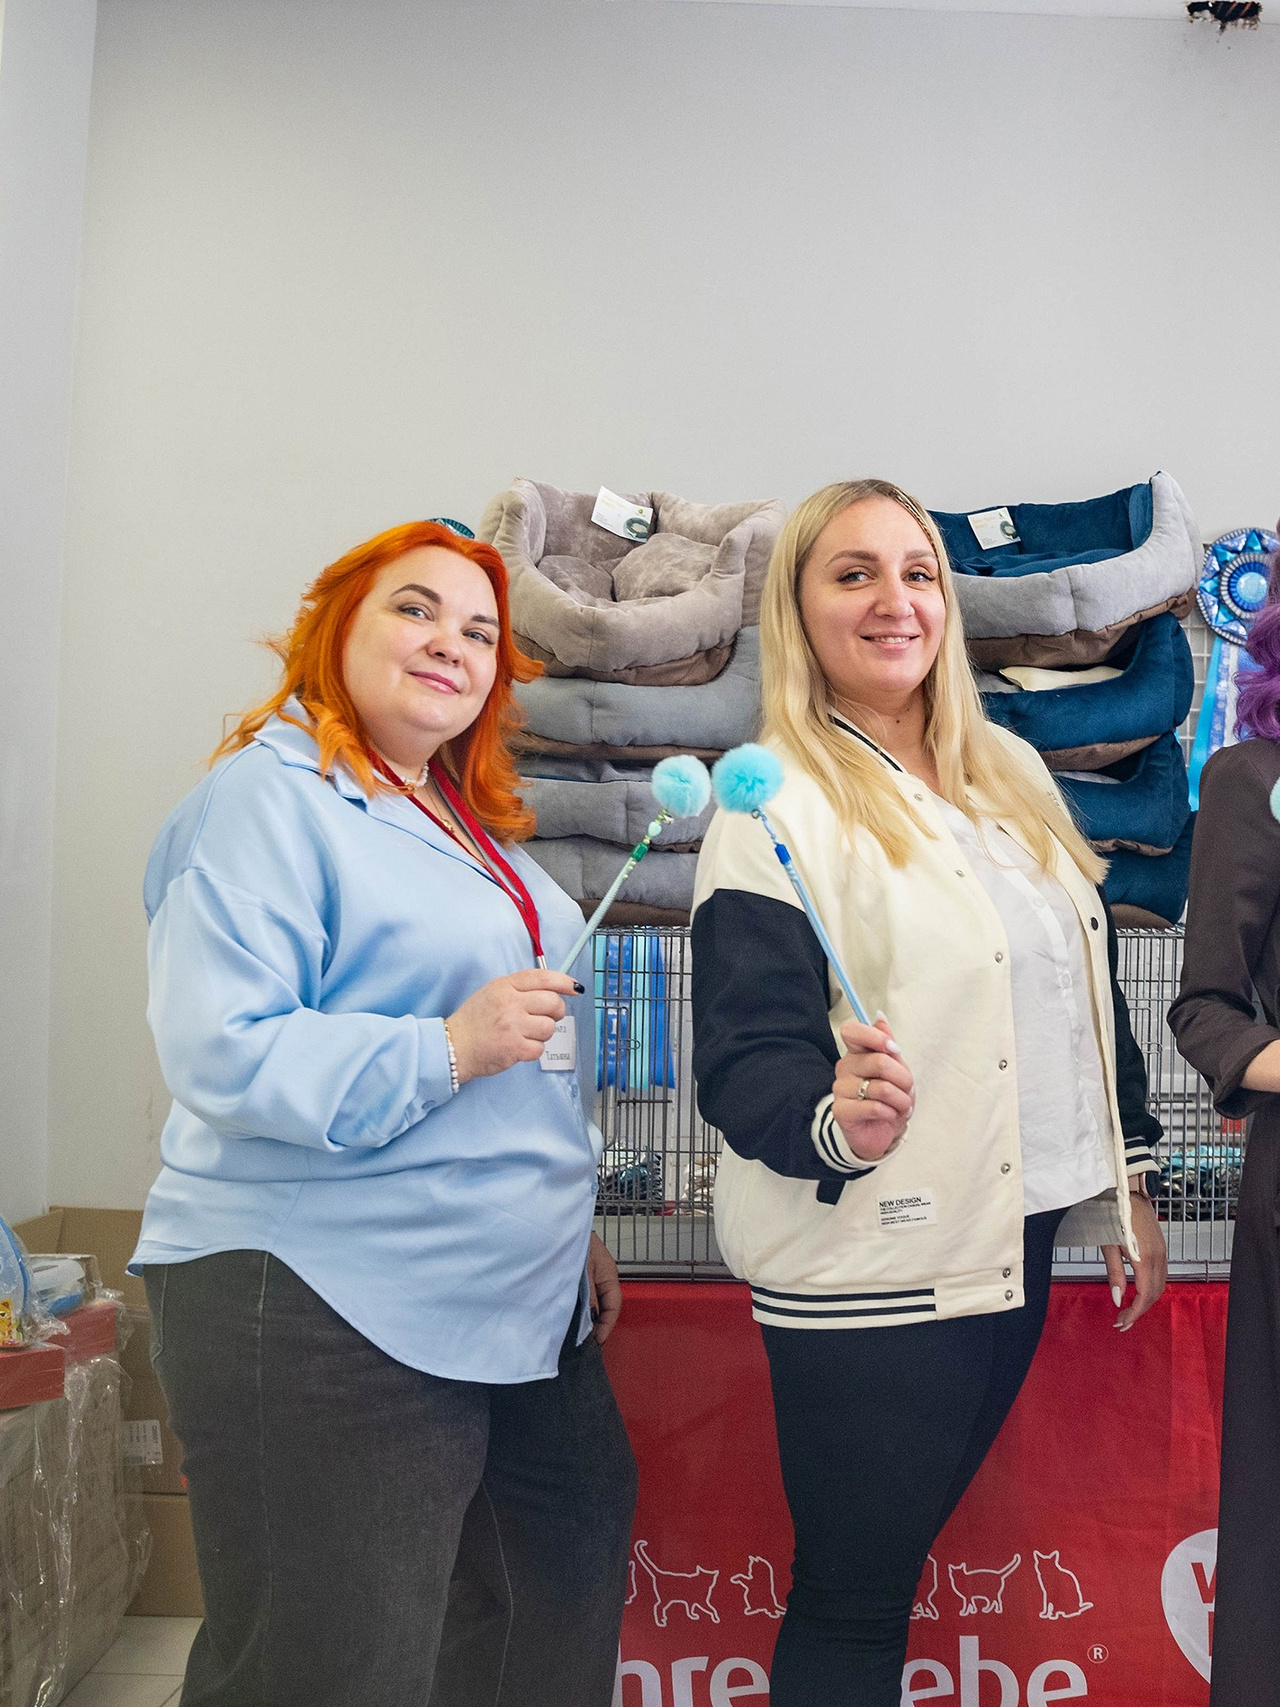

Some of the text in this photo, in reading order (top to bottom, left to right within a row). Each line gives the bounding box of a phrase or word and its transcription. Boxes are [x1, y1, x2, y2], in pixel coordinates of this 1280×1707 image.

[879, 1200, 895, 1208] NEW
[896, 1197, 922, 1206] DESIGN
[611, 1640, 771, 1707] hre
